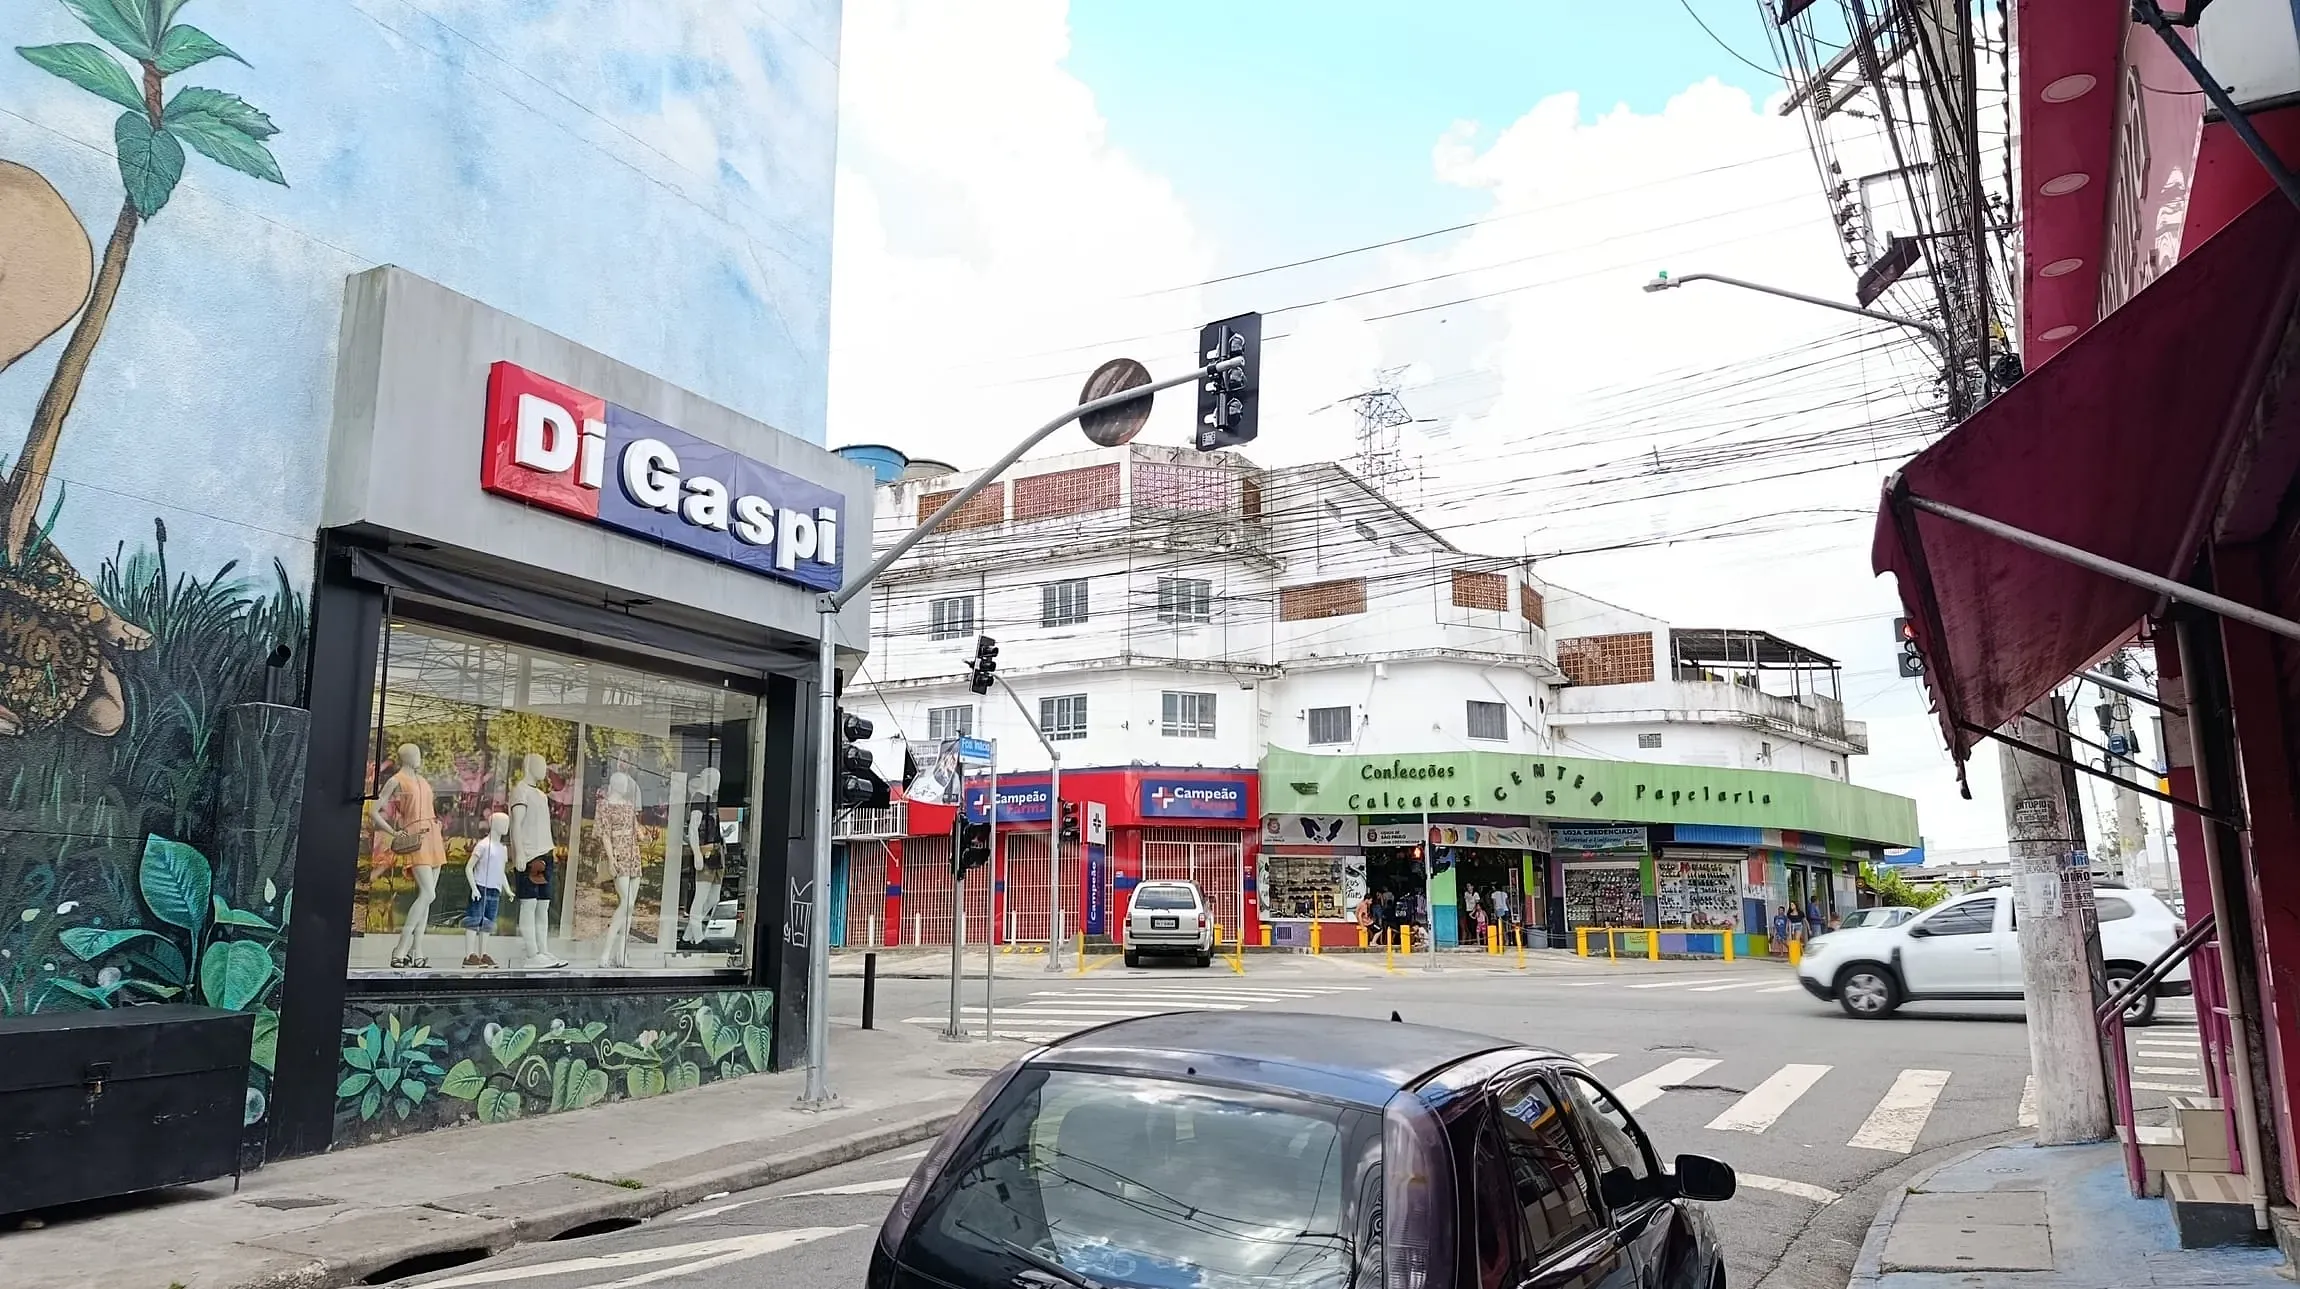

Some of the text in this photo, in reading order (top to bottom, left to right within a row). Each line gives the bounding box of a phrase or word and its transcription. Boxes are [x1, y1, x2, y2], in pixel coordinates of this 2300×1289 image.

[514, 393, 836, 571] Di Gaspi
[1361, 759, 1455, 780] Confecções
[1174, 787, 1237, 801] Campeão
[1494, 763, 1604, 806] CENTER
[1635, 784, 1771, 806] Papelaria
[995, 791, 1047, 805] Campeão
[1545, 790, 1556, 804] 5
[1090, 861, 1098, 921] Campeão
